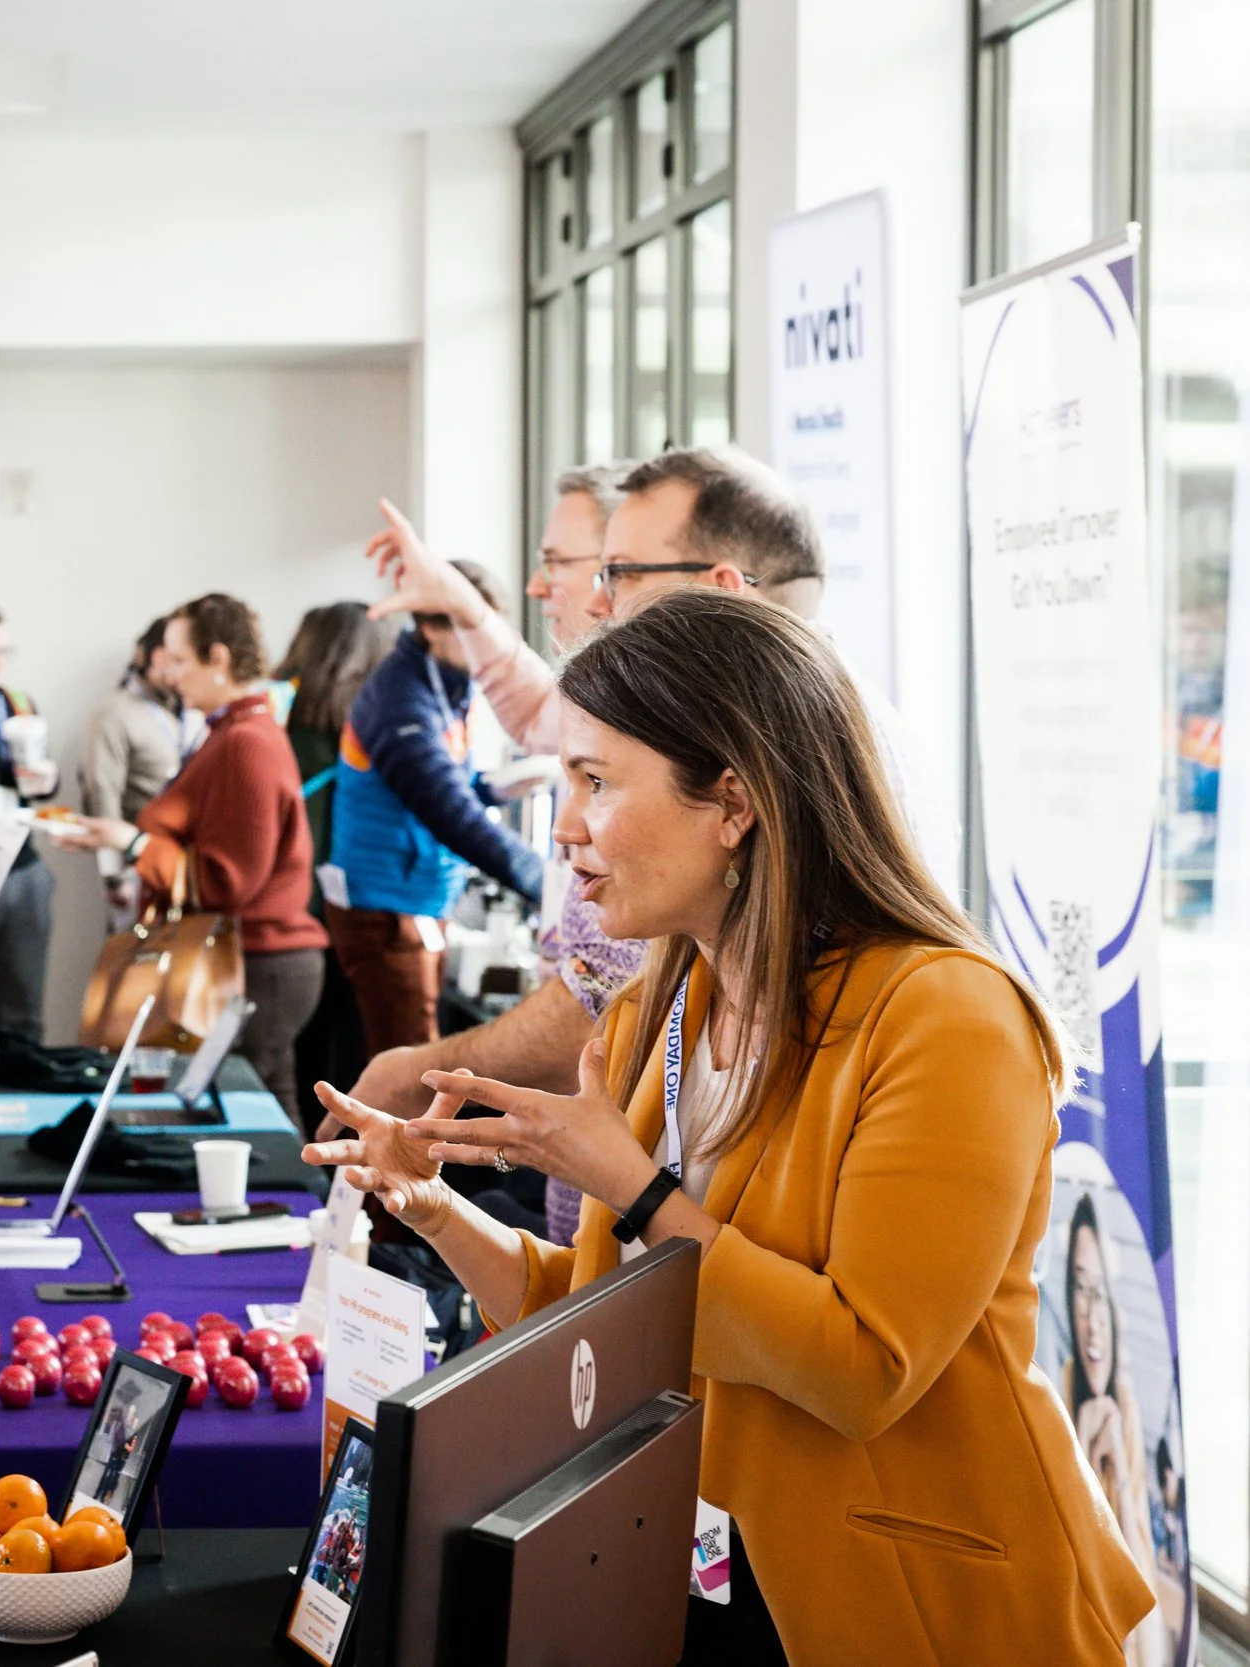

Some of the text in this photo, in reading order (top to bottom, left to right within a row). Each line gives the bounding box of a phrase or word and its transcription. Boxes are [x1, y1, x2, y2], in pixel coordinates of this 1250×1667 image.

[785, 267, 863, 369] nivati
[573, 1338, 593, 1430] hp
[700, 1525, 722, 1543] FROM
[703, 1538, 718, 1553] DAY
